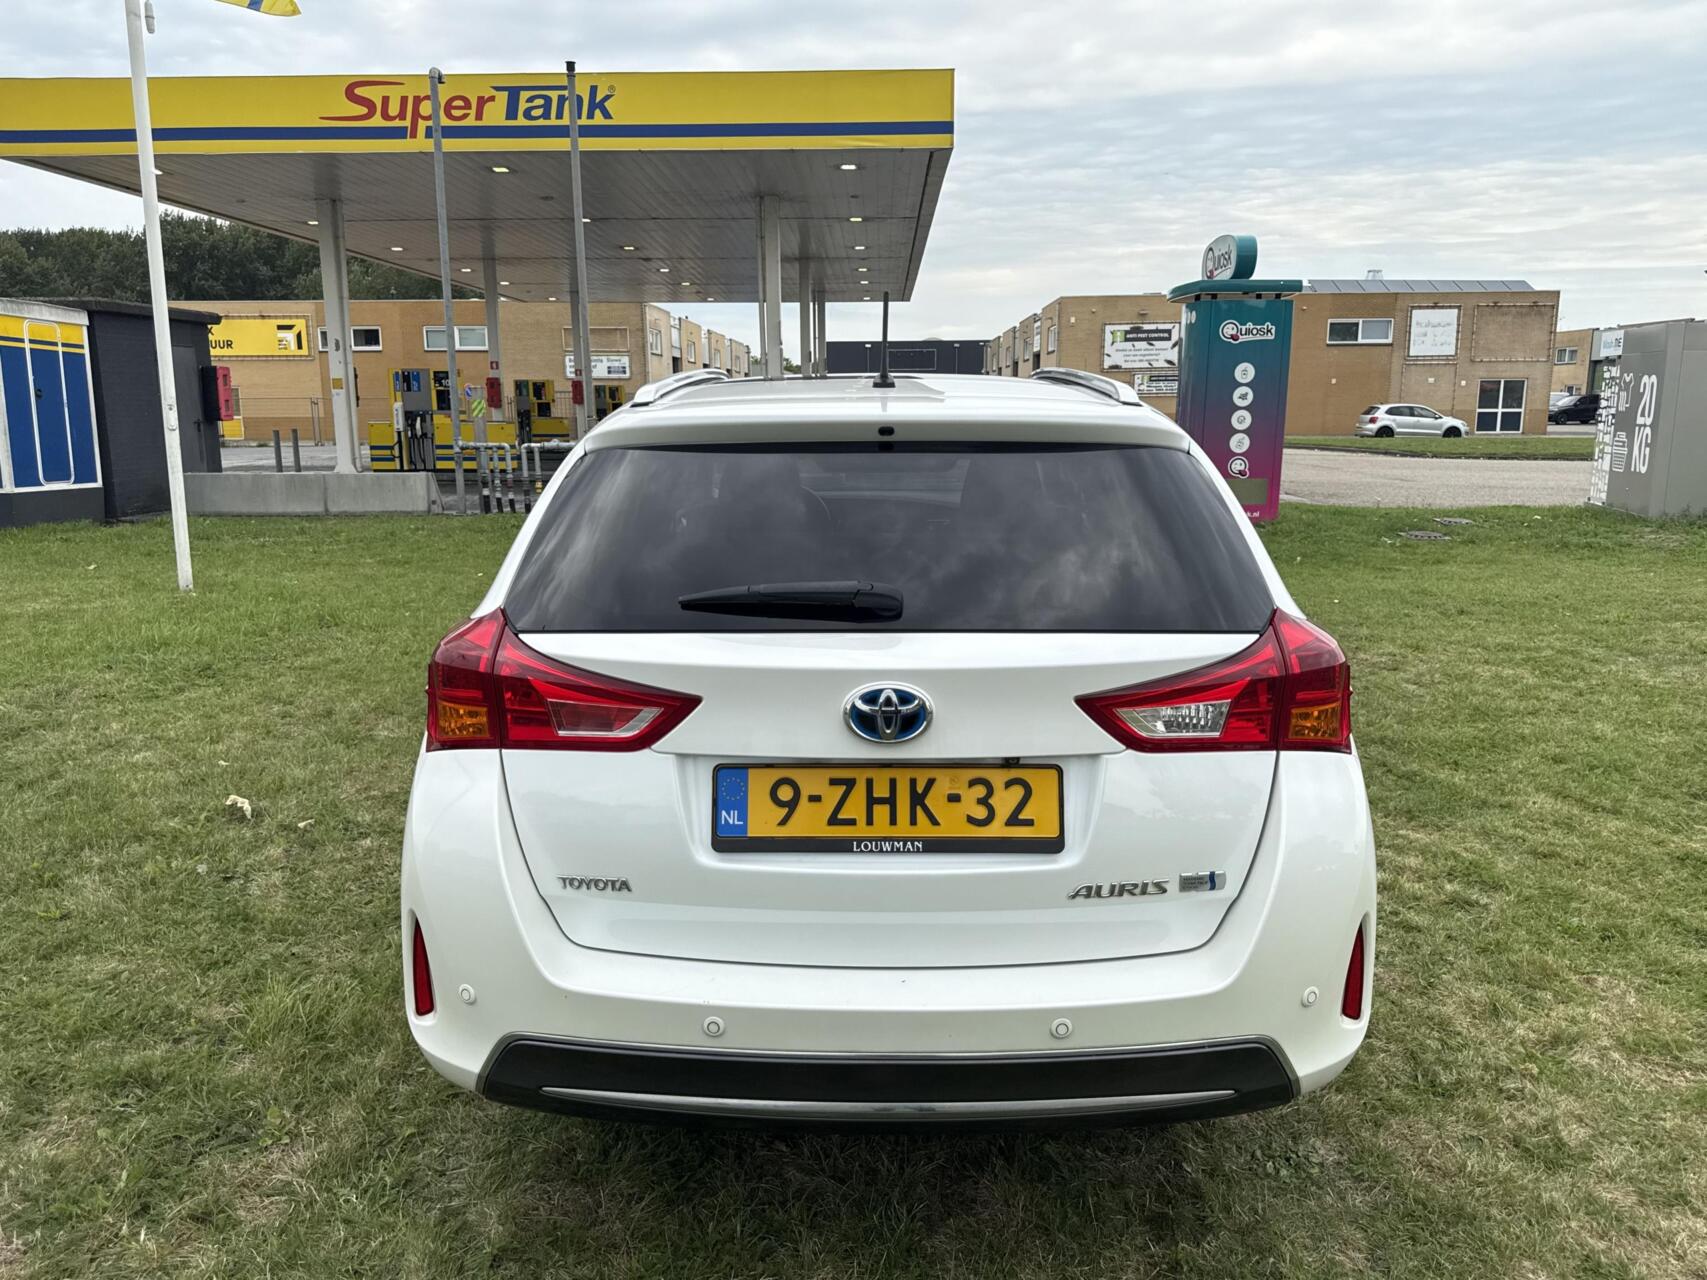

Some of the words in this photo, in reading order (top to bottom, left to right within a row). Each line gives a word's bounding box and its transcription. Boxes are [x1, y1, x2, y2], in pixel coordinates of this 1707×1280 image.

[318, 79, 615, 139] SuperTank
[1205, 244, 1233, 279] Quiosk
[1220, 321, 1275, 342] Quiosk
[1636, 374, 1658, 426] 20
[1631, 426, 1652, 474] KG
[721, 810, 744, 825] NL
[769, 777, 1035, 827] 9-ZHK-32
[853, 841, 923, 852] LOUWMAN
[557, 876, 632, 892] TOYOTA
[1068, 878, 1170, 900] AURIS
